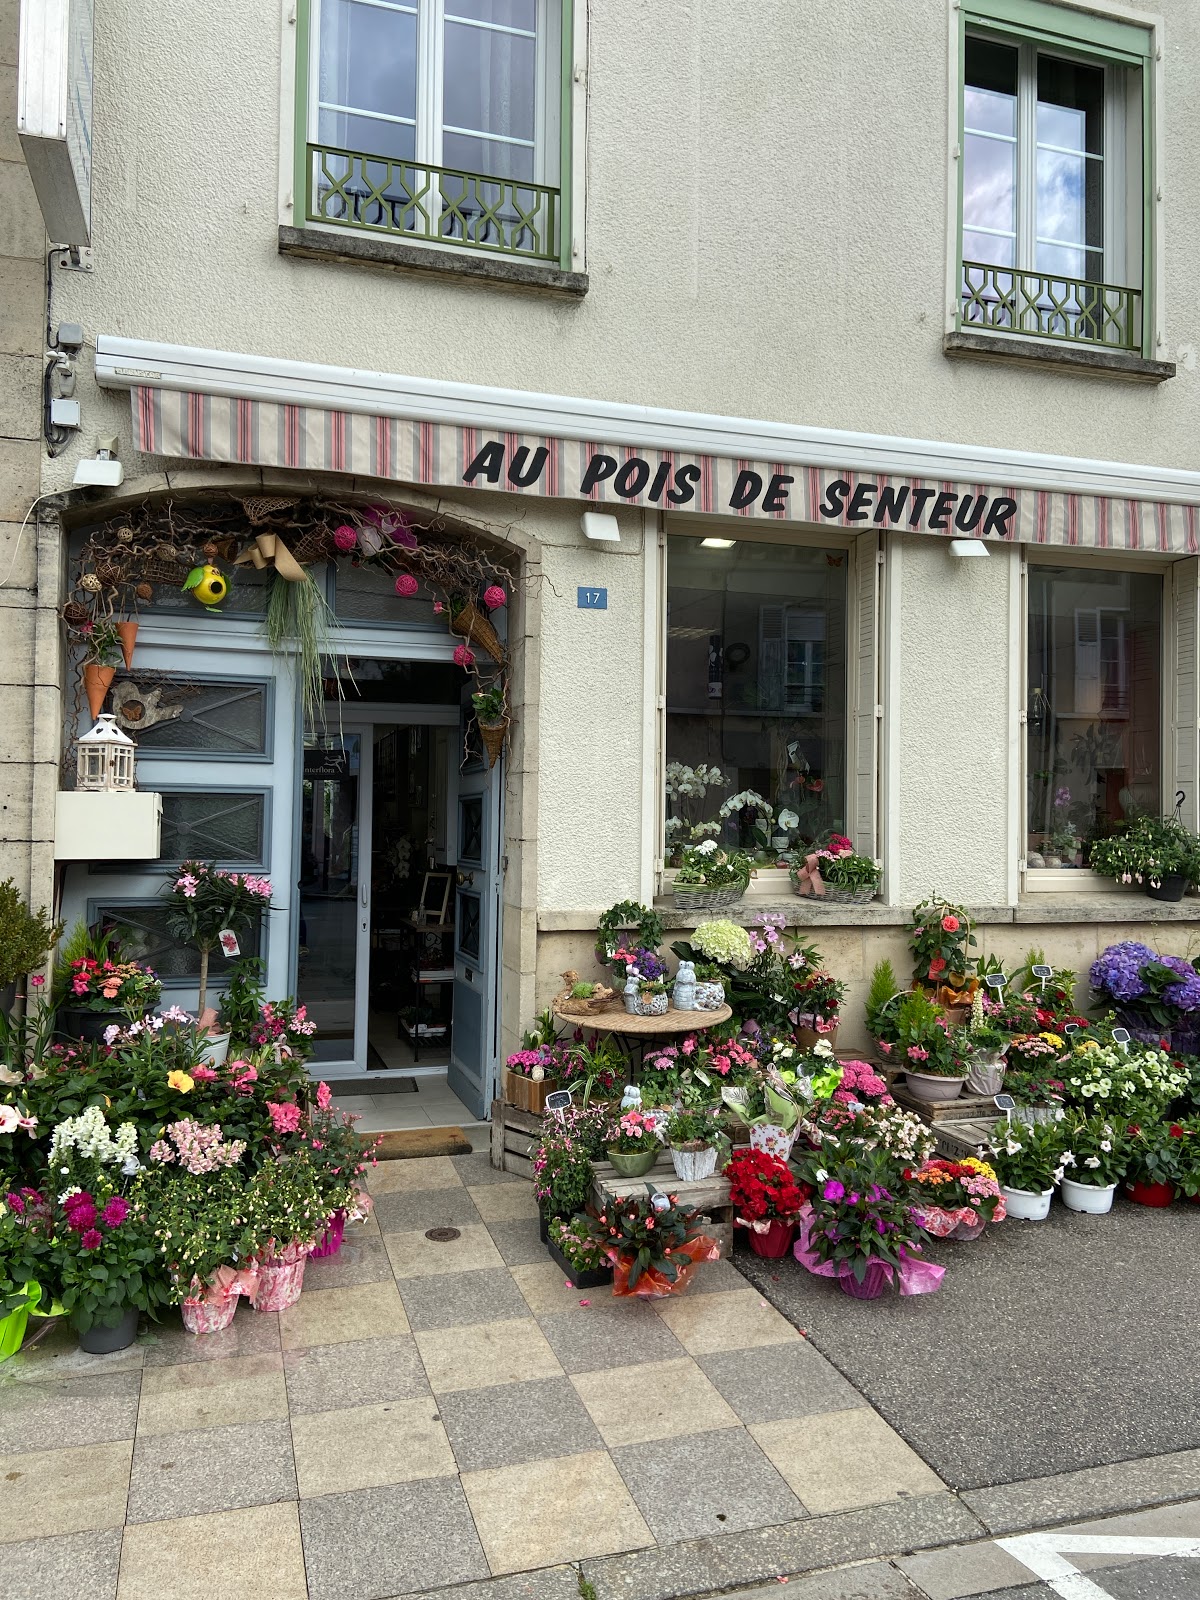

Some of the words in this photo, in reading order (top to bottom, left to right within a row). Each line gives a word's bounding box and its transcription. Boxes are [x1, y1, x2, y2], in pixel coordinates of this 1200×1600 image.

[462, 440, 550, 487] AU
[579, 453, 701, 504] POIS
[728, 470, 795, 512] DE
[819, 479, 1018, 536] SENTEUR
[586, 592, 600, 604] 17
[304, 765, 335, 773] nterflora
